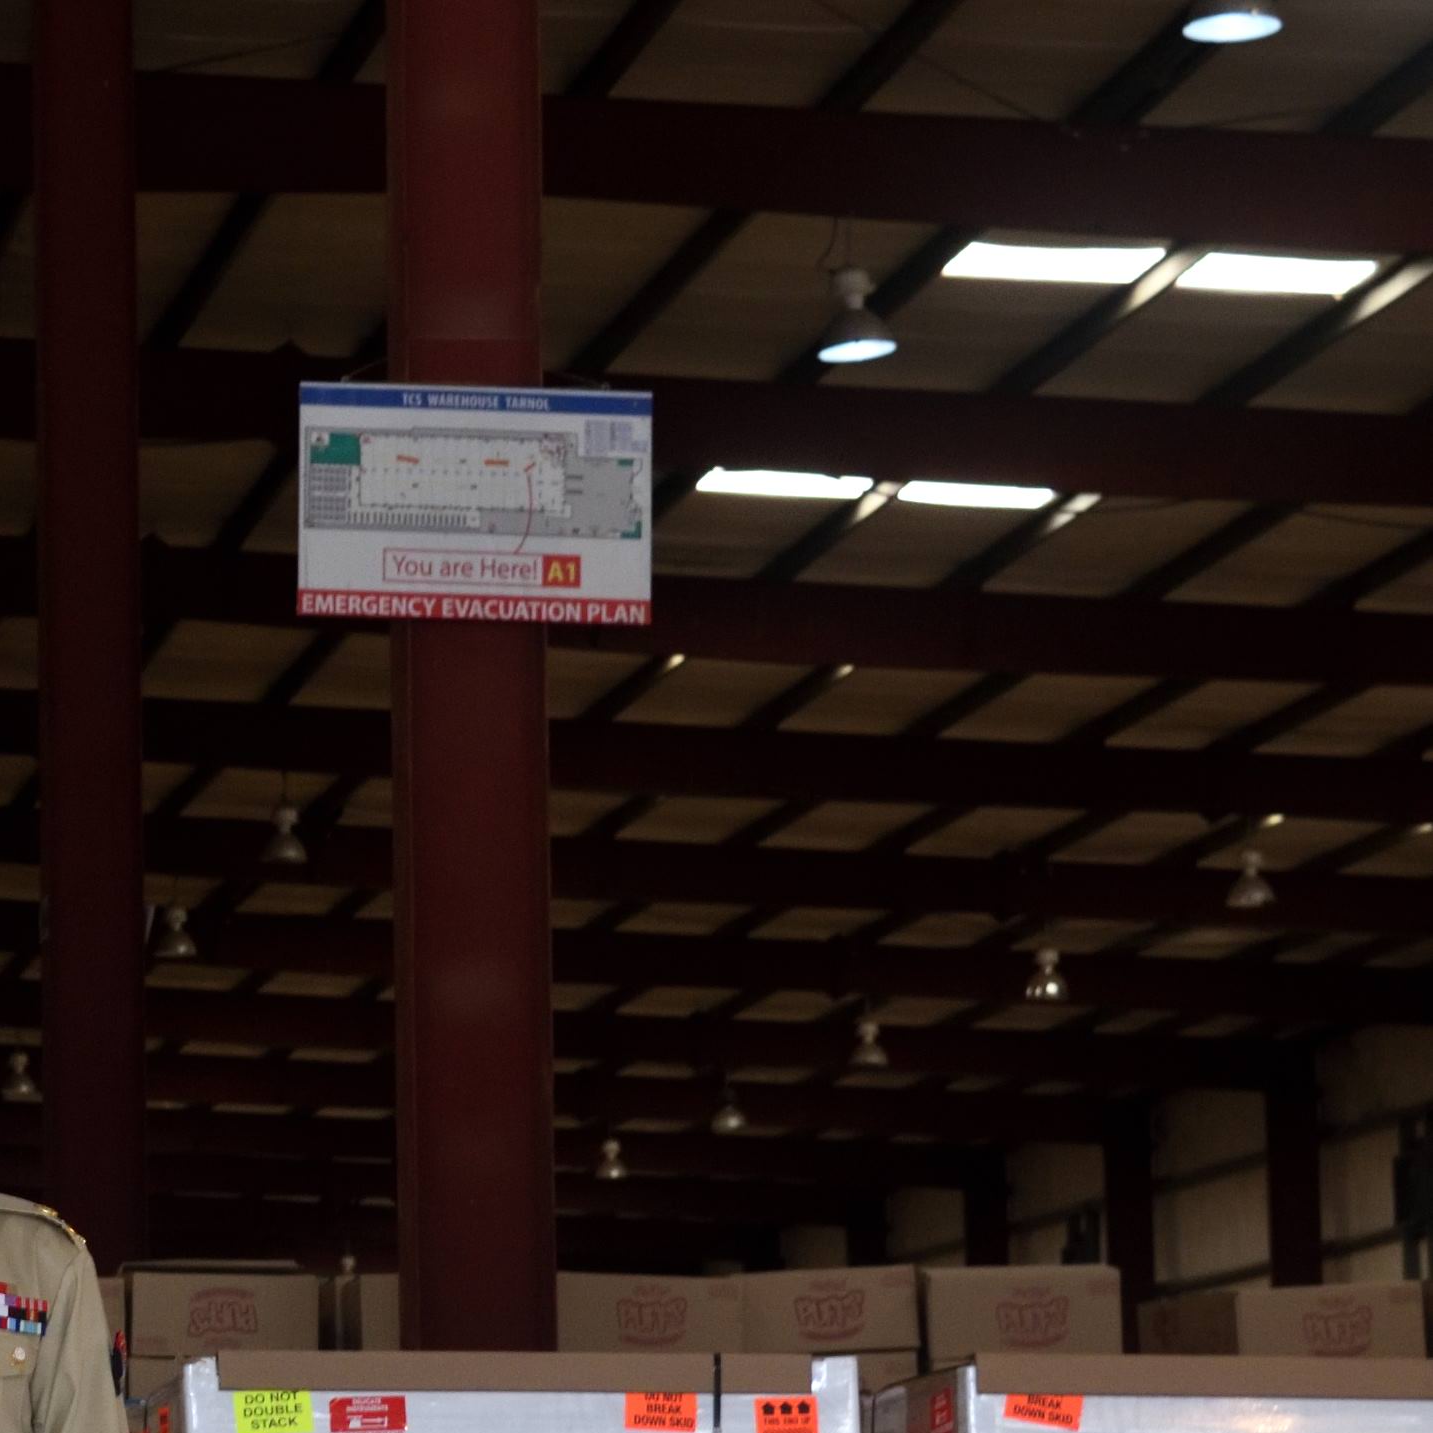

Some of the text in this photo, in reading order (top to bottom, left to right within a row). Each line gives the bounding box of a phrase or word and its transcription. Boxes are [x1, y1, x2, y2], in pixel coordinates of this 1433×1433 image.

[427, 393, 499, 410] WAREHOUSE
[393, 554, 537, 581] You are Here!
[547, 561, 577, 583] A1
[301, 593, 647, 624] EMERGENCY EVACUATION PLAN
[244, 1391, 299, 1405] DO NOT
[1027, 1394, 1063, 1409] BREAK
[243, 1403, 303, 1418] DOUBLE
[646, 1404, 681, 1414] BREAK
[1013, 1404, 1073, 1425] DOWN SKID
[250, 1417, 298, 1430] STACK
[634, 1415, 694, 1428] DOWN SKID
